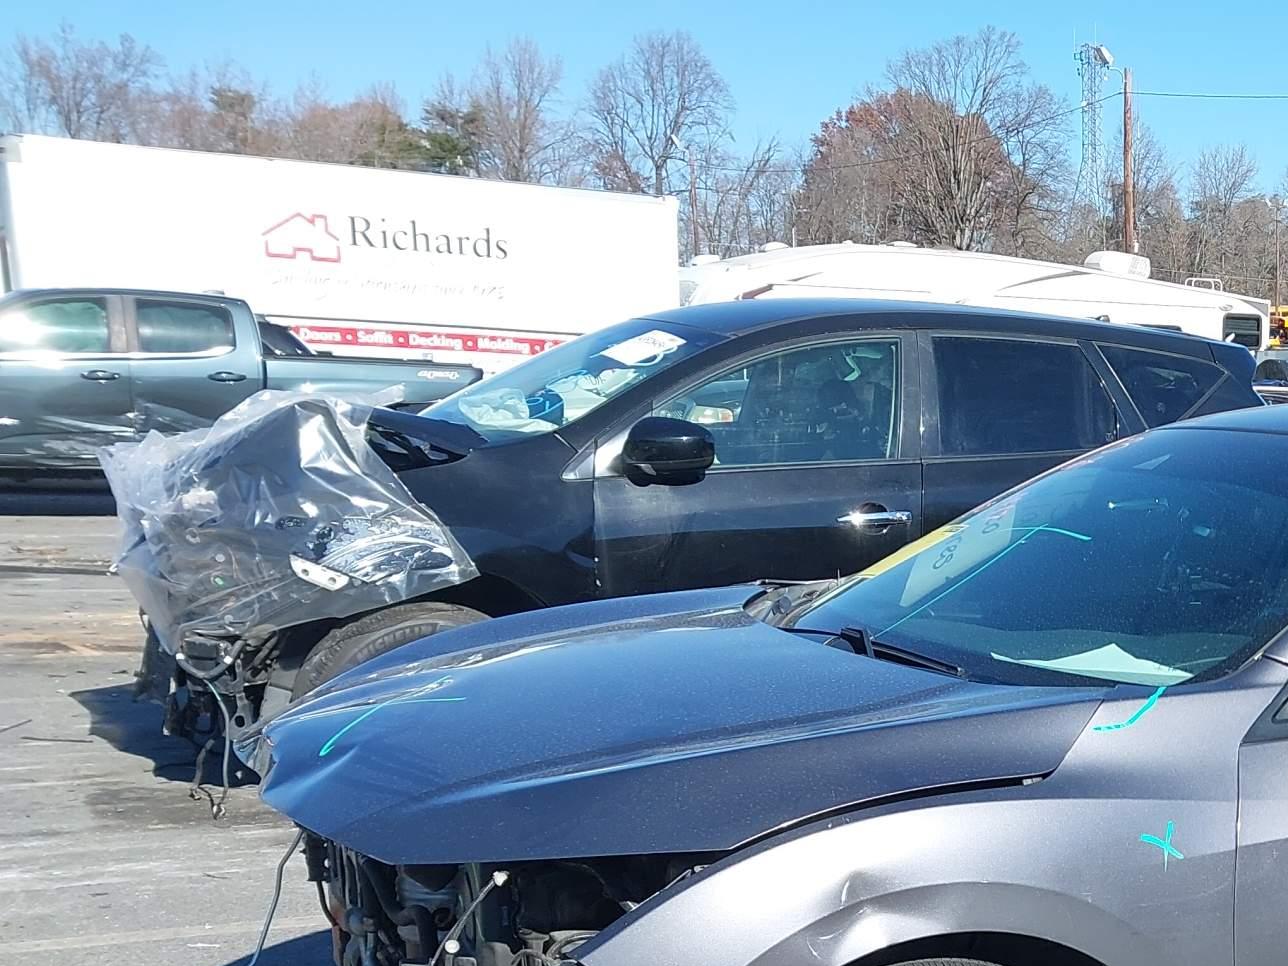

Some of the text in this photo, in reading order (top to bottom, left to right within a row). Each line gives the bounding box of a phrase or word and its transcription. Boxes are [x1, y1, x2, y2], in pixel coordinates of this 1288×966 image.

[348, 215, 508, 260] Richards
[300, 329, 342, 342] Doors
[408, 334, 463, 350] Decking
[477, 337, 530, 354] Molding
